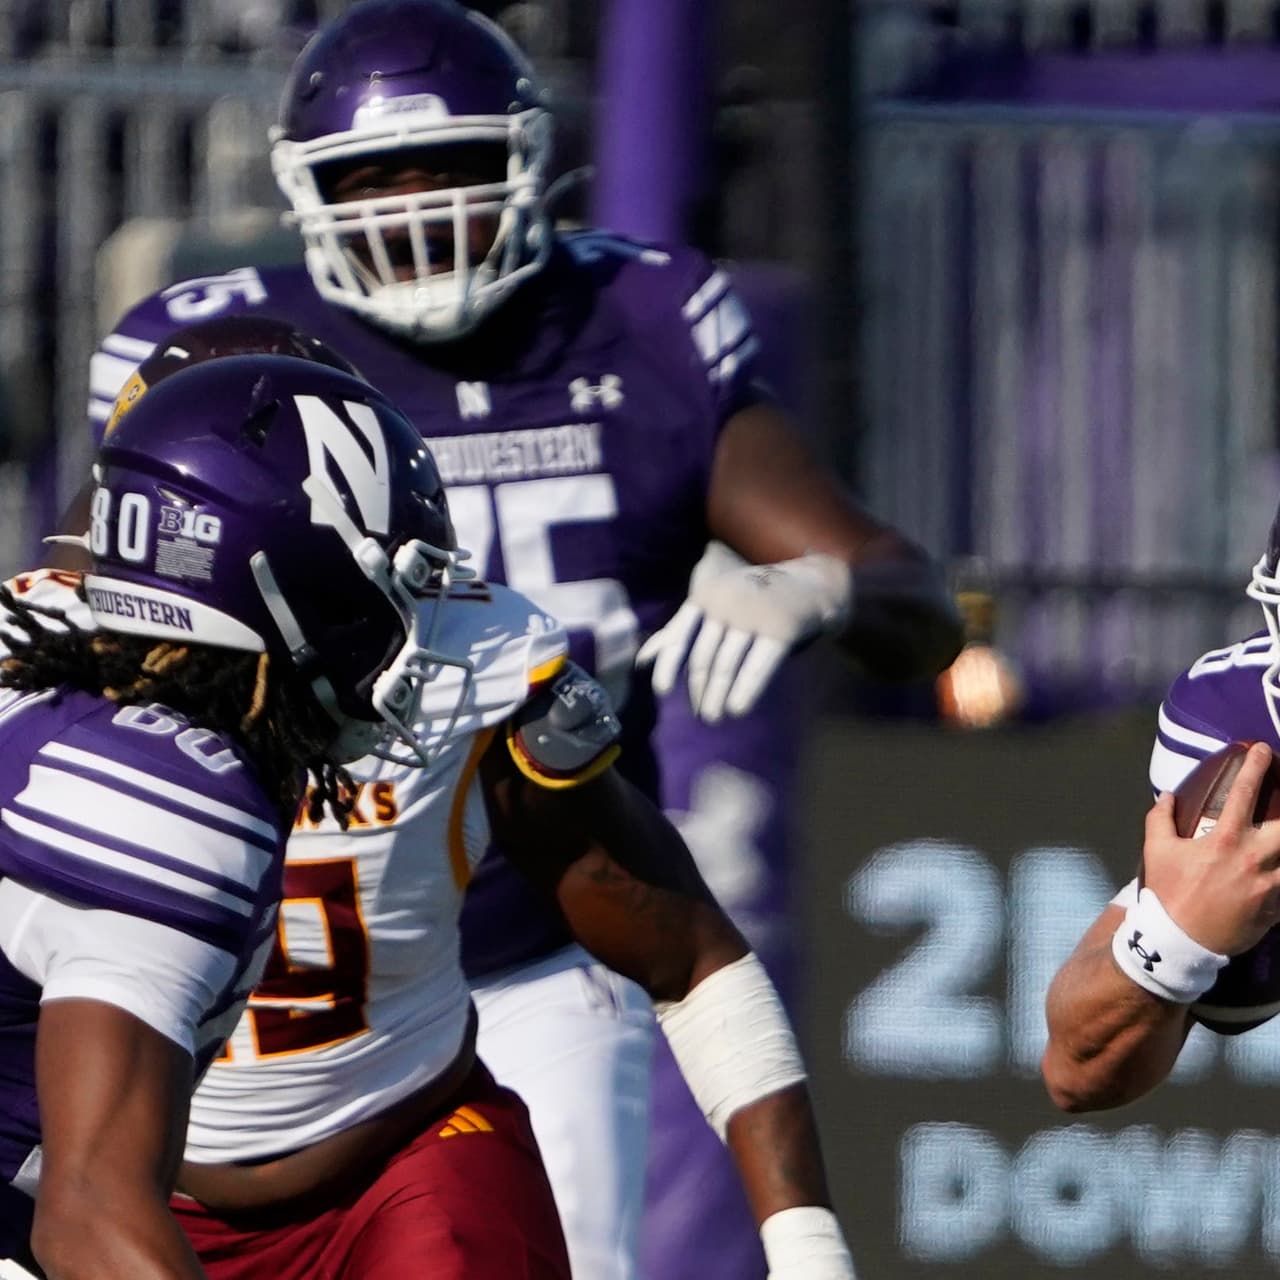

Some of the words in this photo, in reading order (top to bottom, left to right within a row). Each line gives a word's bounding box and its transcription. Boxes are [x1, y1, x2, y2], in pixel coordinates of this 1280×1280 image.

[90, 487, 151, 562] 80
[293, 394, 390, 536] N
[205, 855, 373, 1064] 9
